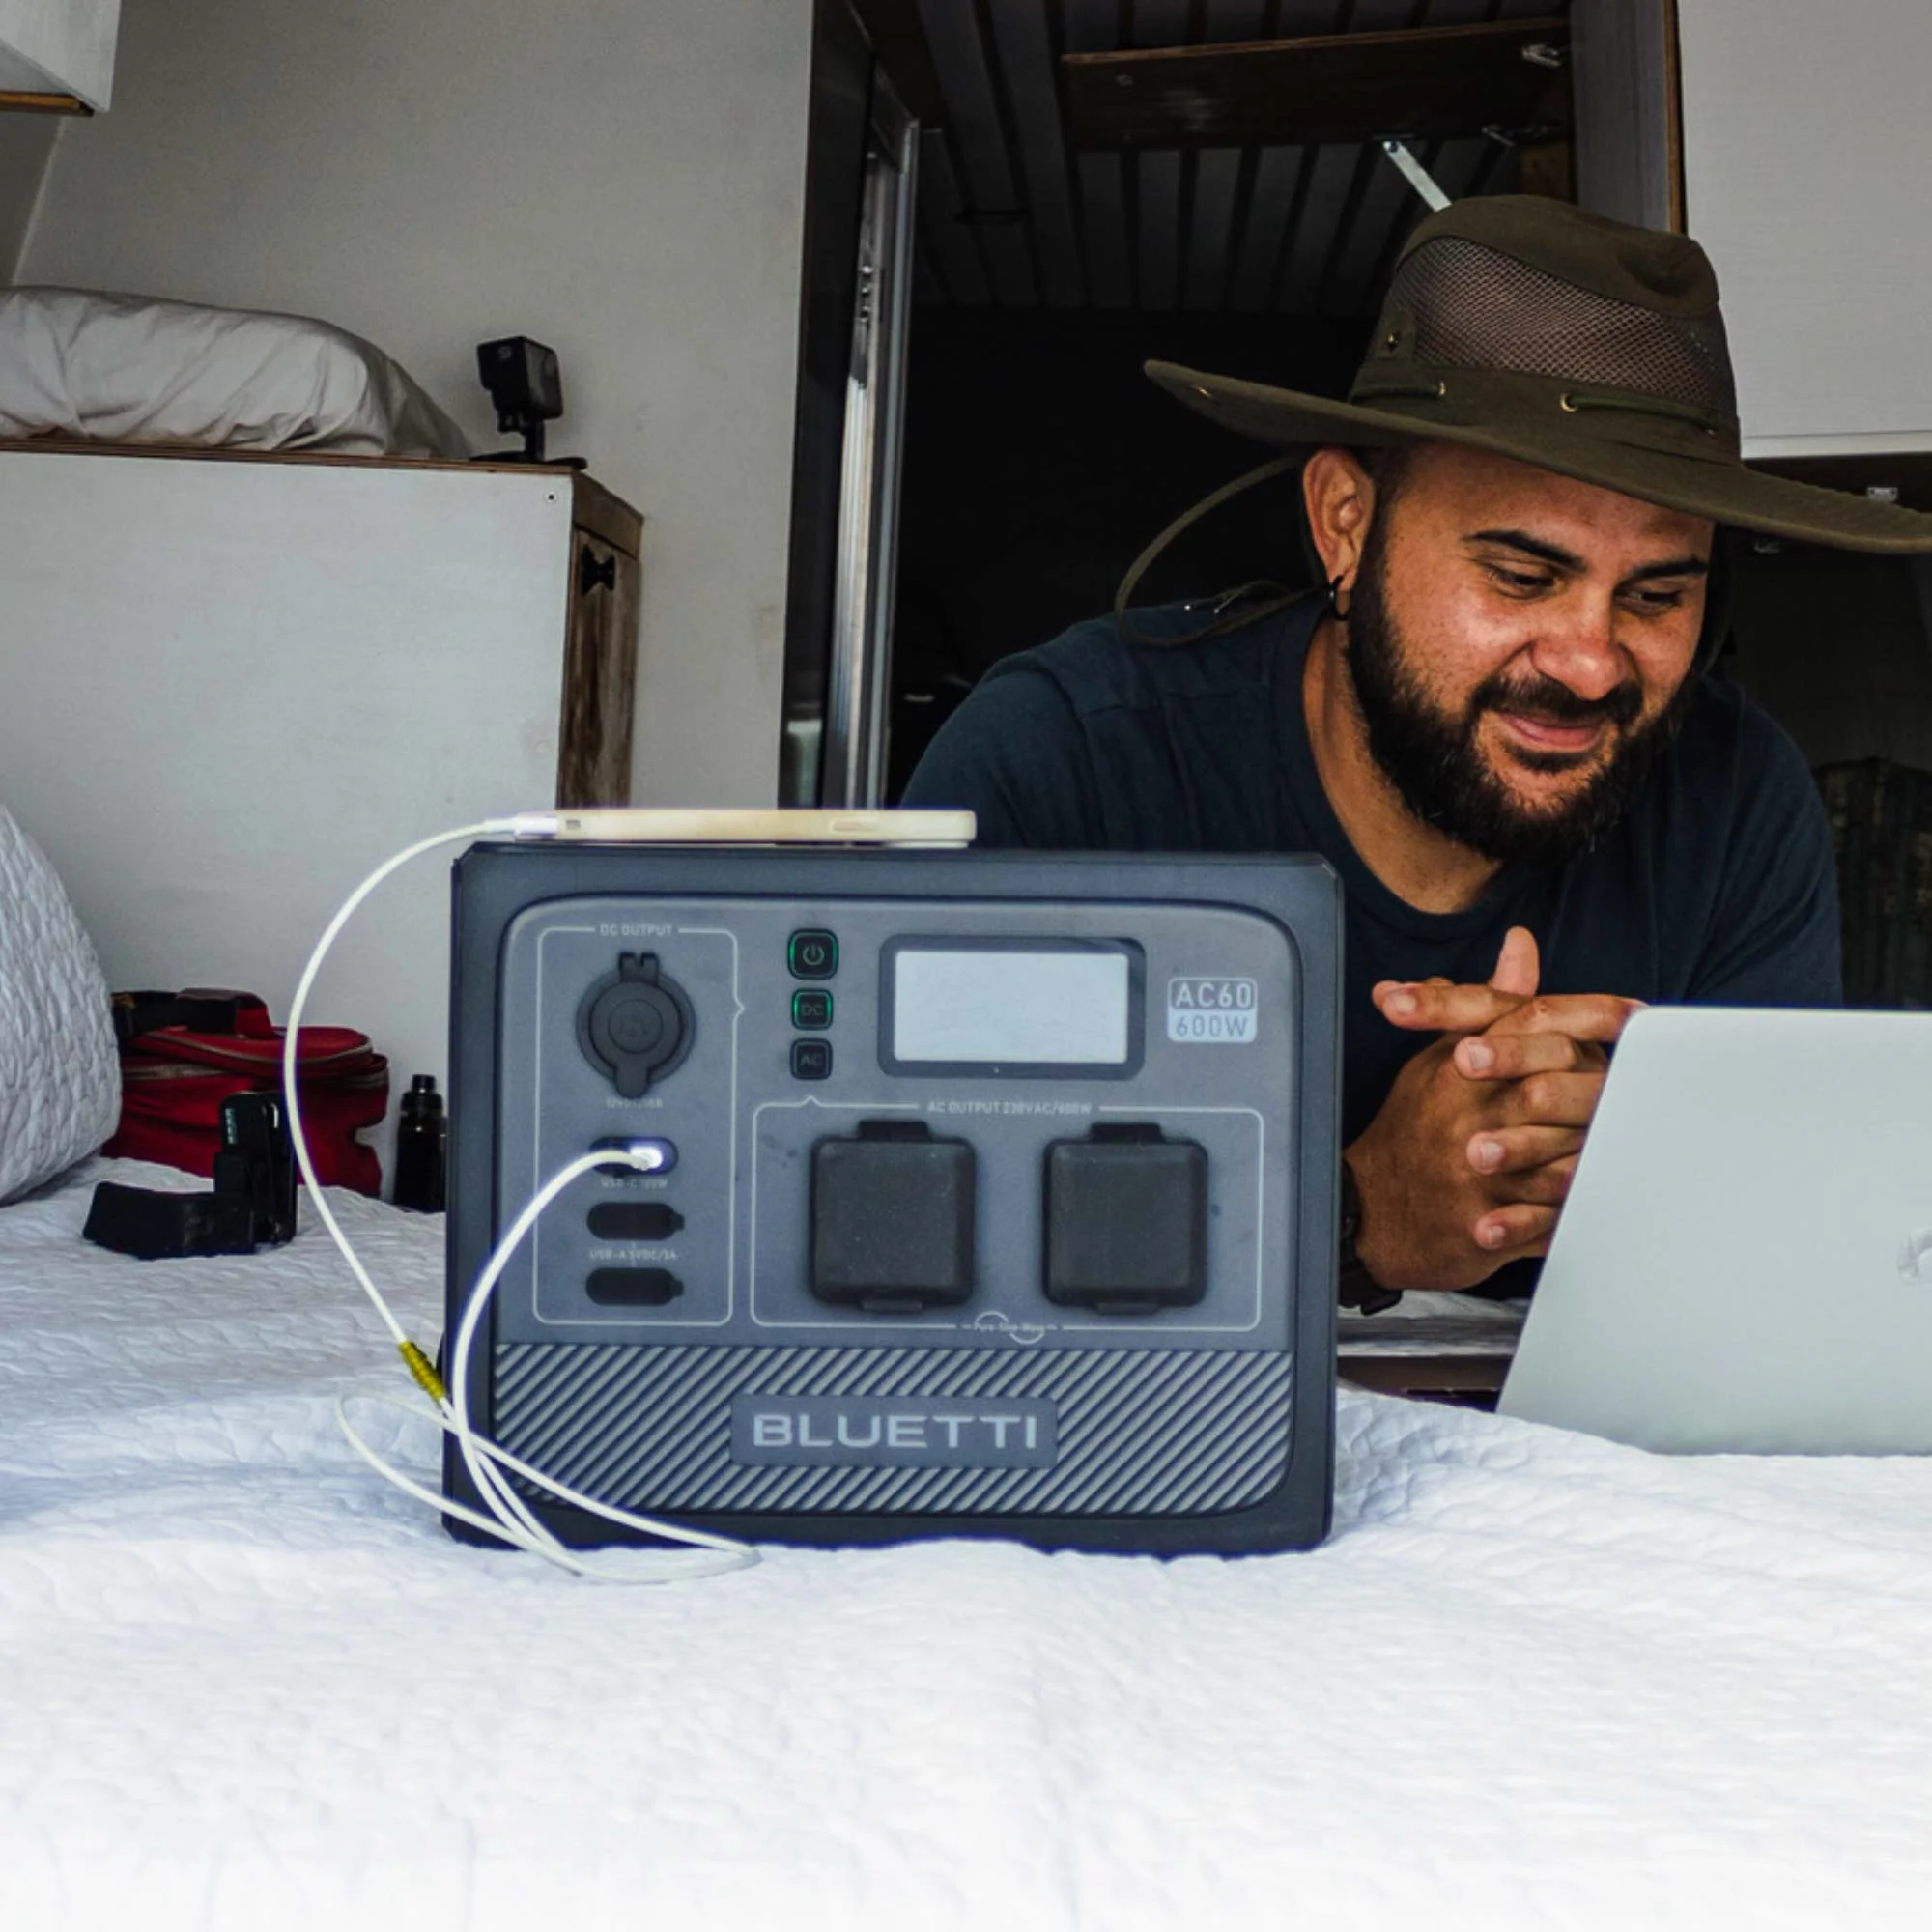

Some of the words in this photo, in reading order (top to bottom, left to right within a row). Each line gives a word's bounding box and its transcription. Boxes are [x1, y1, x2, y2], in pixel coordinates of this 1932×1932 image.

[600, 923, 618, 936] DC
[621, 923, 673, 937] OUTPUT
[1175, 981, 1252, 1008] AC60
[801, 1003, 825, 1016] DC
[1176, 1014, 1249, 1037] 600W
[800, 1054, 824, 1067] AC
[927, 1100, 946, 1113] AC
[948, 1100, 1001, 1114] OUTPUT
[753, 1414, 1037, 1448] BLUETTI
